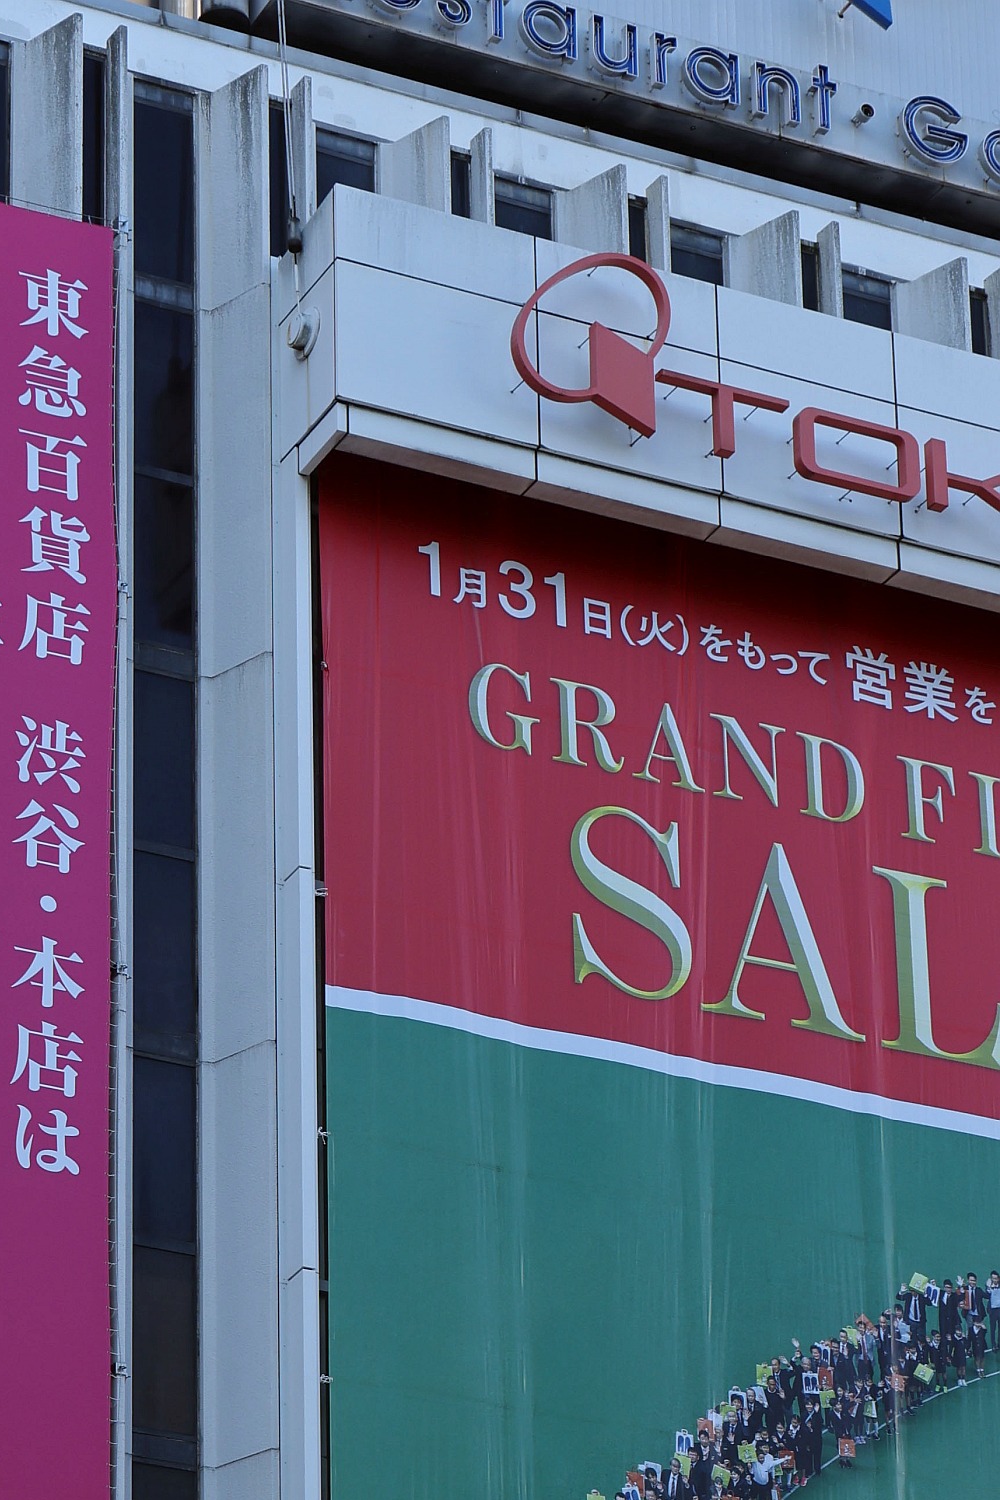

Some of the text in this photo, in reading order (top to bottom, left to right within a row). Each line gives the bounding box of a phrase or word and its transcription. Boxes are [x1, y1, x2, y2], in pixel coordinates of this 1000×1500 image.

[10, 268, 91, 1176] 東急百貨店 渋谷・本店は
[467, 662, 865, 823] GRAND
[569, 804, 1000, 1069] SAL
